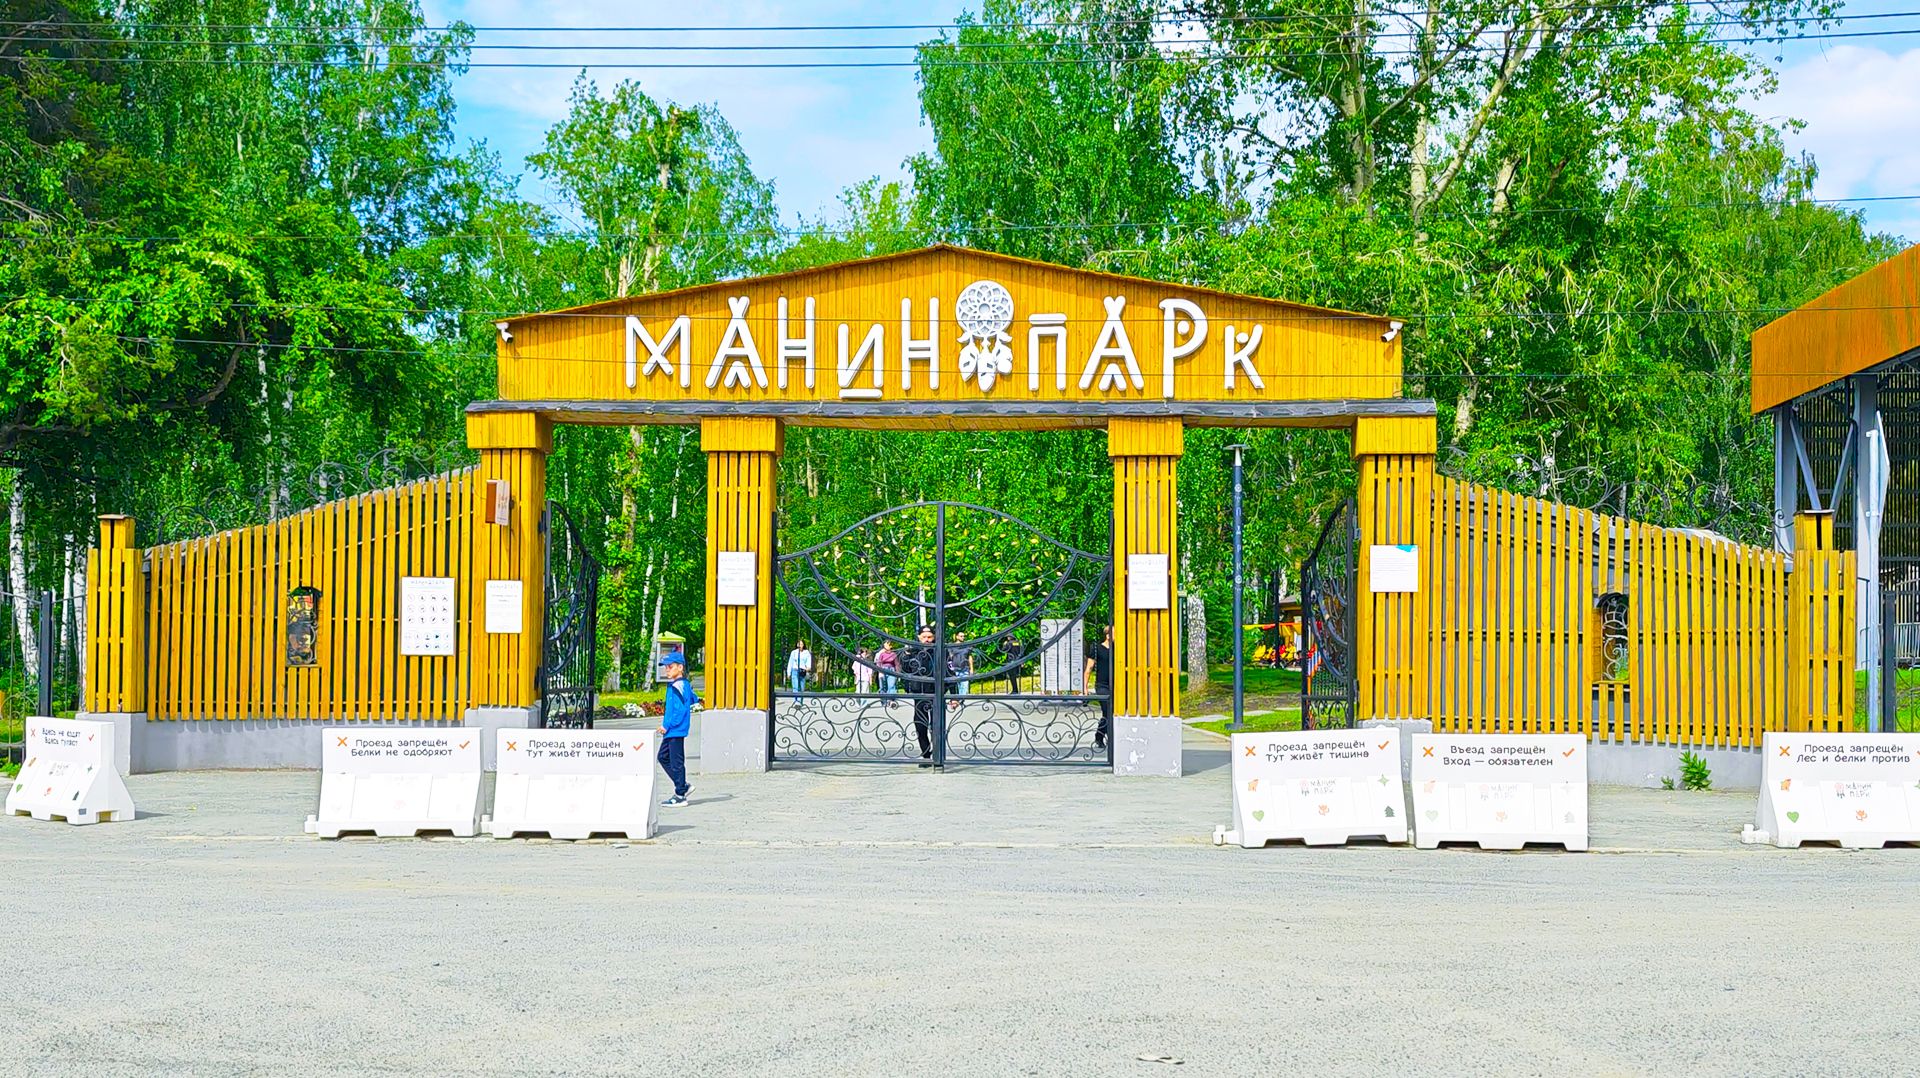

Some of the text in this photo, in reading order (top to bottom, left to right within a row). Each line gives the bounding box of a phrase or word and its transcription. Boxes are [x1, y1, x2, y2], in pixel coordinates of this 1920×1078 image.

[625, 295, 1265, 399] МАНИН ПАРК
[355, 739, 448, 748] Проезд запрещён
[528, 739, 621, 750] Проезд запрещён
[1268, 740, 1366, 753] Проезд запрещён
[351, 748, 381, 756] Белки
[403, 748, 453, 757] одобряют
[526, 749, 624, 758] Тут живёт тишина
[1450, 745, 1546, 755] Въезд запрещён
[1804, 744, 1904, 754] Проезд запрещён
[1265, 750, 1370, 763] Тут живёт тишина
[1443, 757, 1471, 766] Вход
[1488, 757, 1554, 766] обязателен
[1796, 754, 1817, 763] Лес
[1834, 754, 1867, 763] белки
[1871, 755, 1910, 764] против
